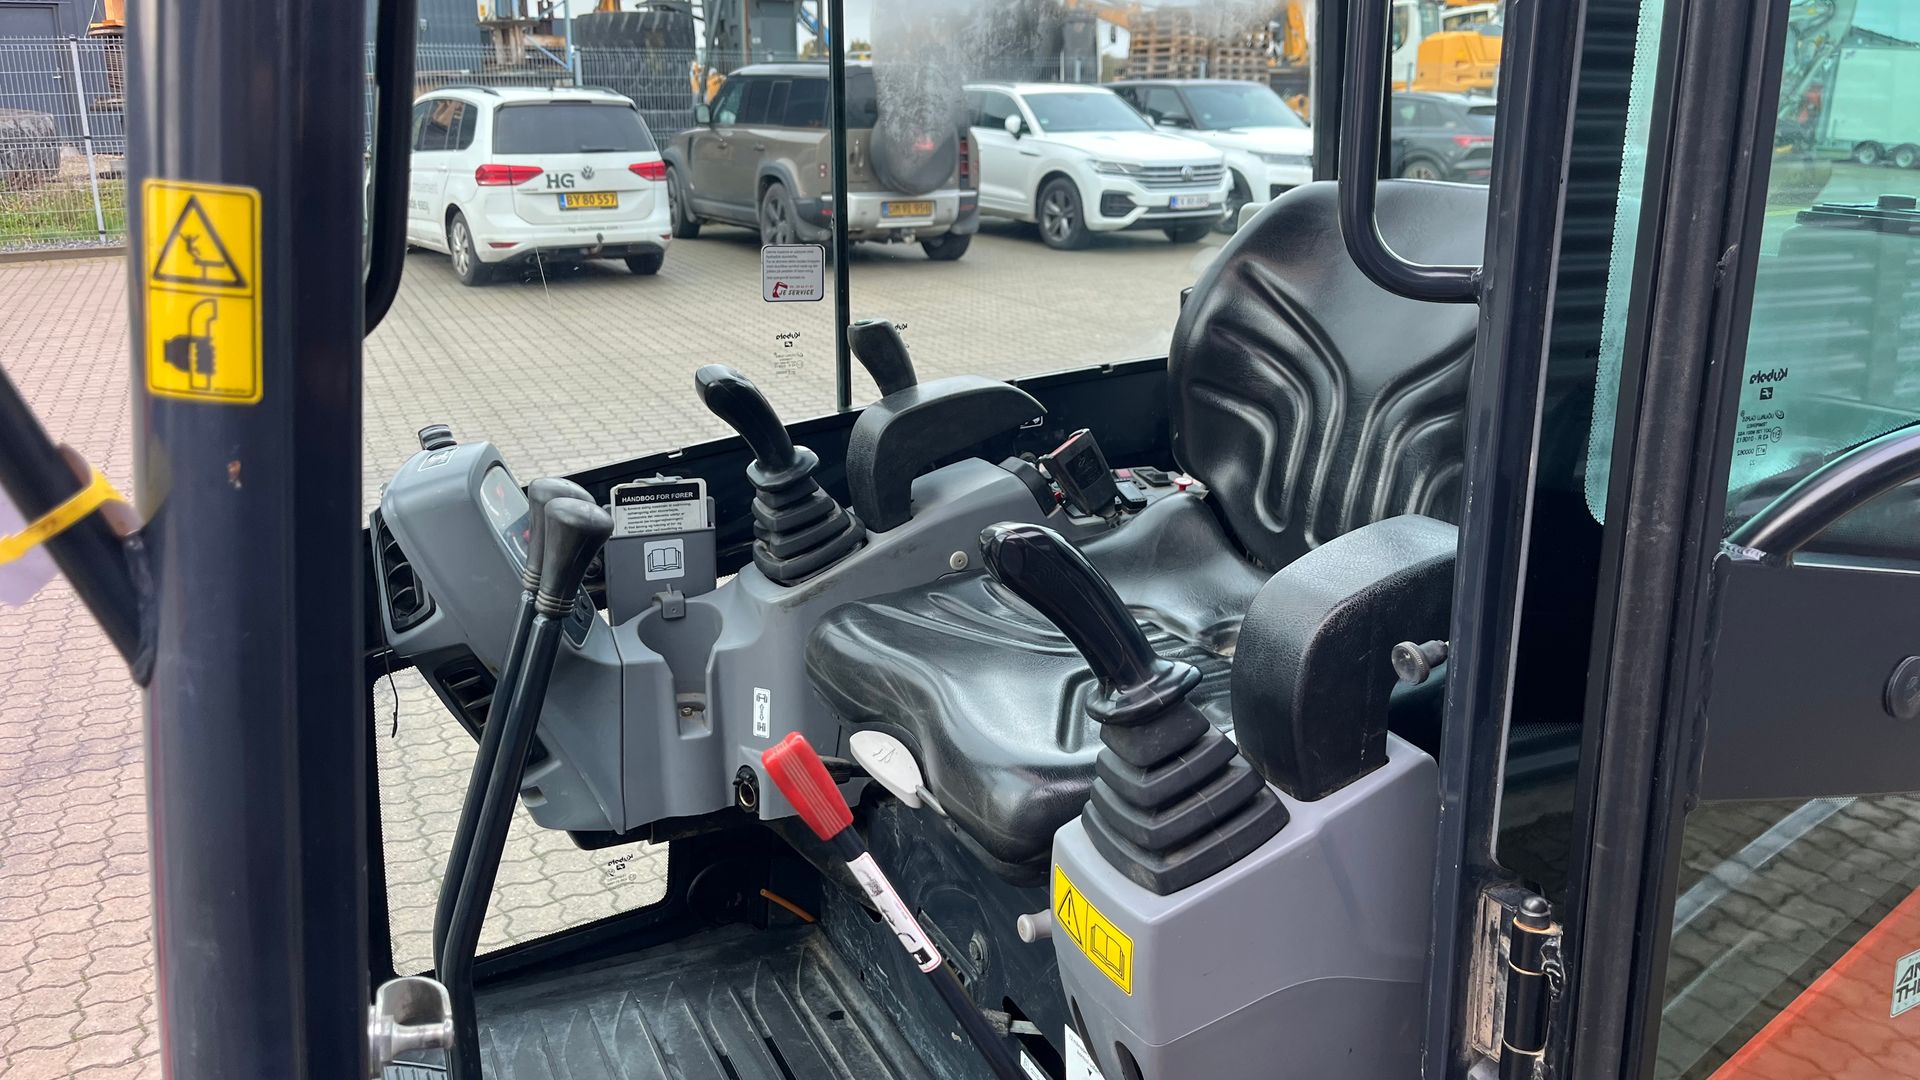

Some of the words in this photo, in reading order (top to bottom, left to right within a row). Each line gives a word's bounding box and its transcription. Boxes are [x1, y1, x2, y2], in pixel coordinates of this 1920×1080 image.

[546, 173, 575, 189] HG
[566, 193, 580, 206] BY
[583, 193, 596, 206] 80
[597, 193, 616, 206] 557
[671, 491, 694, 499] FØRER
